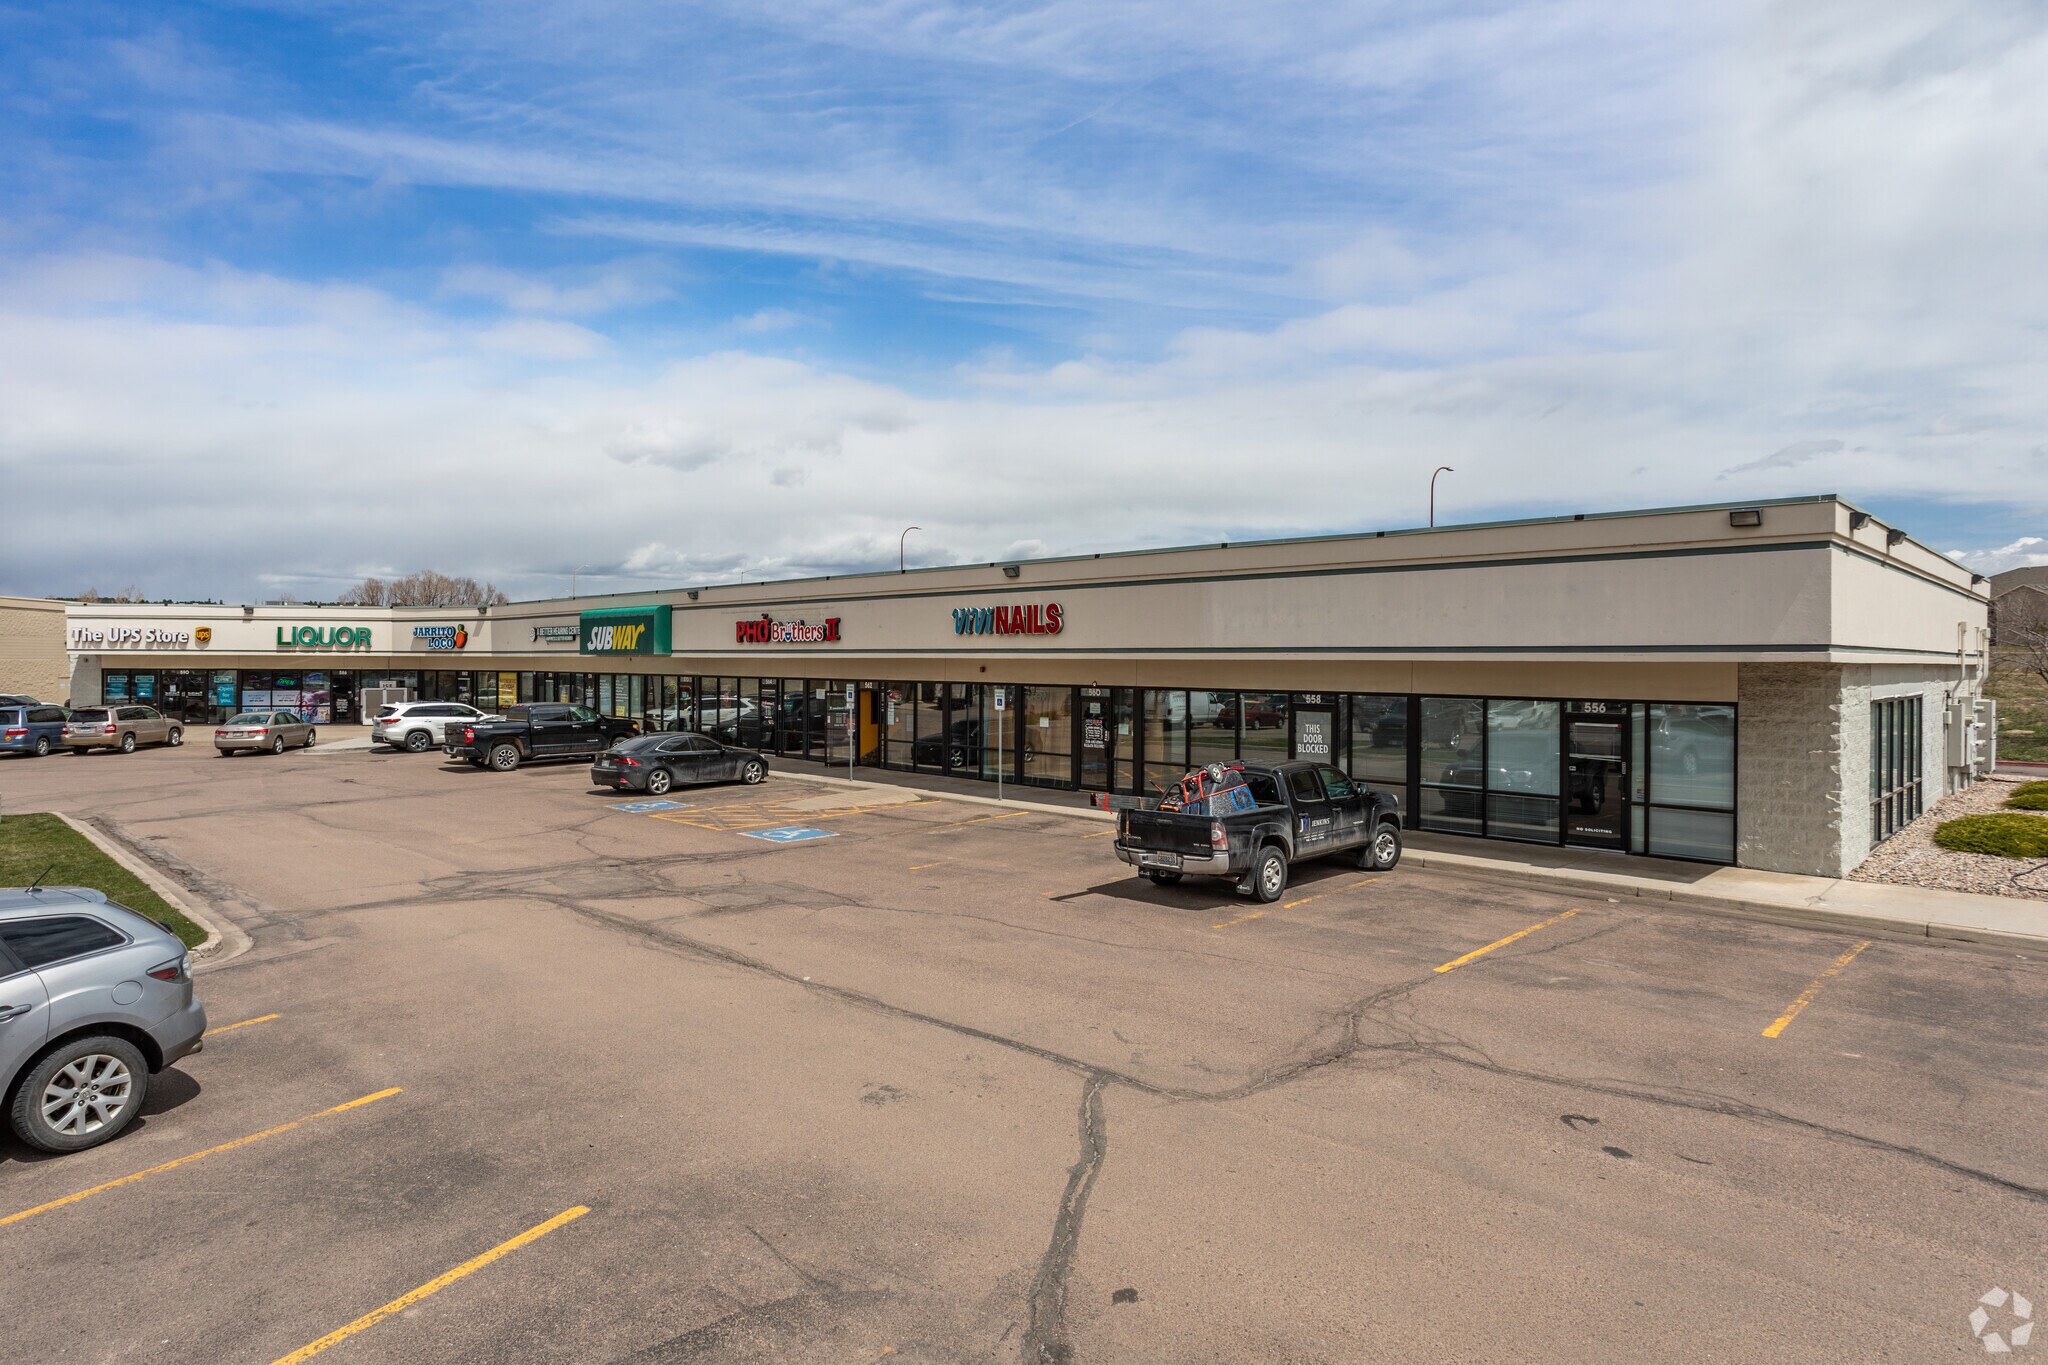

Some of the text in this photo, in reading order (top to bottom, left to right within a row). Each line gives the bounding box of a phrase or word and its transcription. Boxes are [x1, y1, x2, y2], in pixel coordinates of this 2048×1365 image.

[995, 603, 1063, 635] NAILS
[72, 627, 189, 642] The UPS Store
[413, 626, 455, 637] JARRITO
[568, 626, 580, 635] CENTE
[276, 626, 372, 648] LIQUOR
[587, 623, 645, 651] SUBWAY
[427, 638, 455, 649] LOCO
[278, 678, 295, 686] OPEN
[1305, 694, 1322, 704] 558
[1584, 702, 1606, 713] 556
[1305, 723, 1321, 734] THIS
[1303, 733, 1323, 744] DOOR
[1297, 743, 1329, 754] BLOCKED
[1311, 817, 1330, 827] JENKINS
